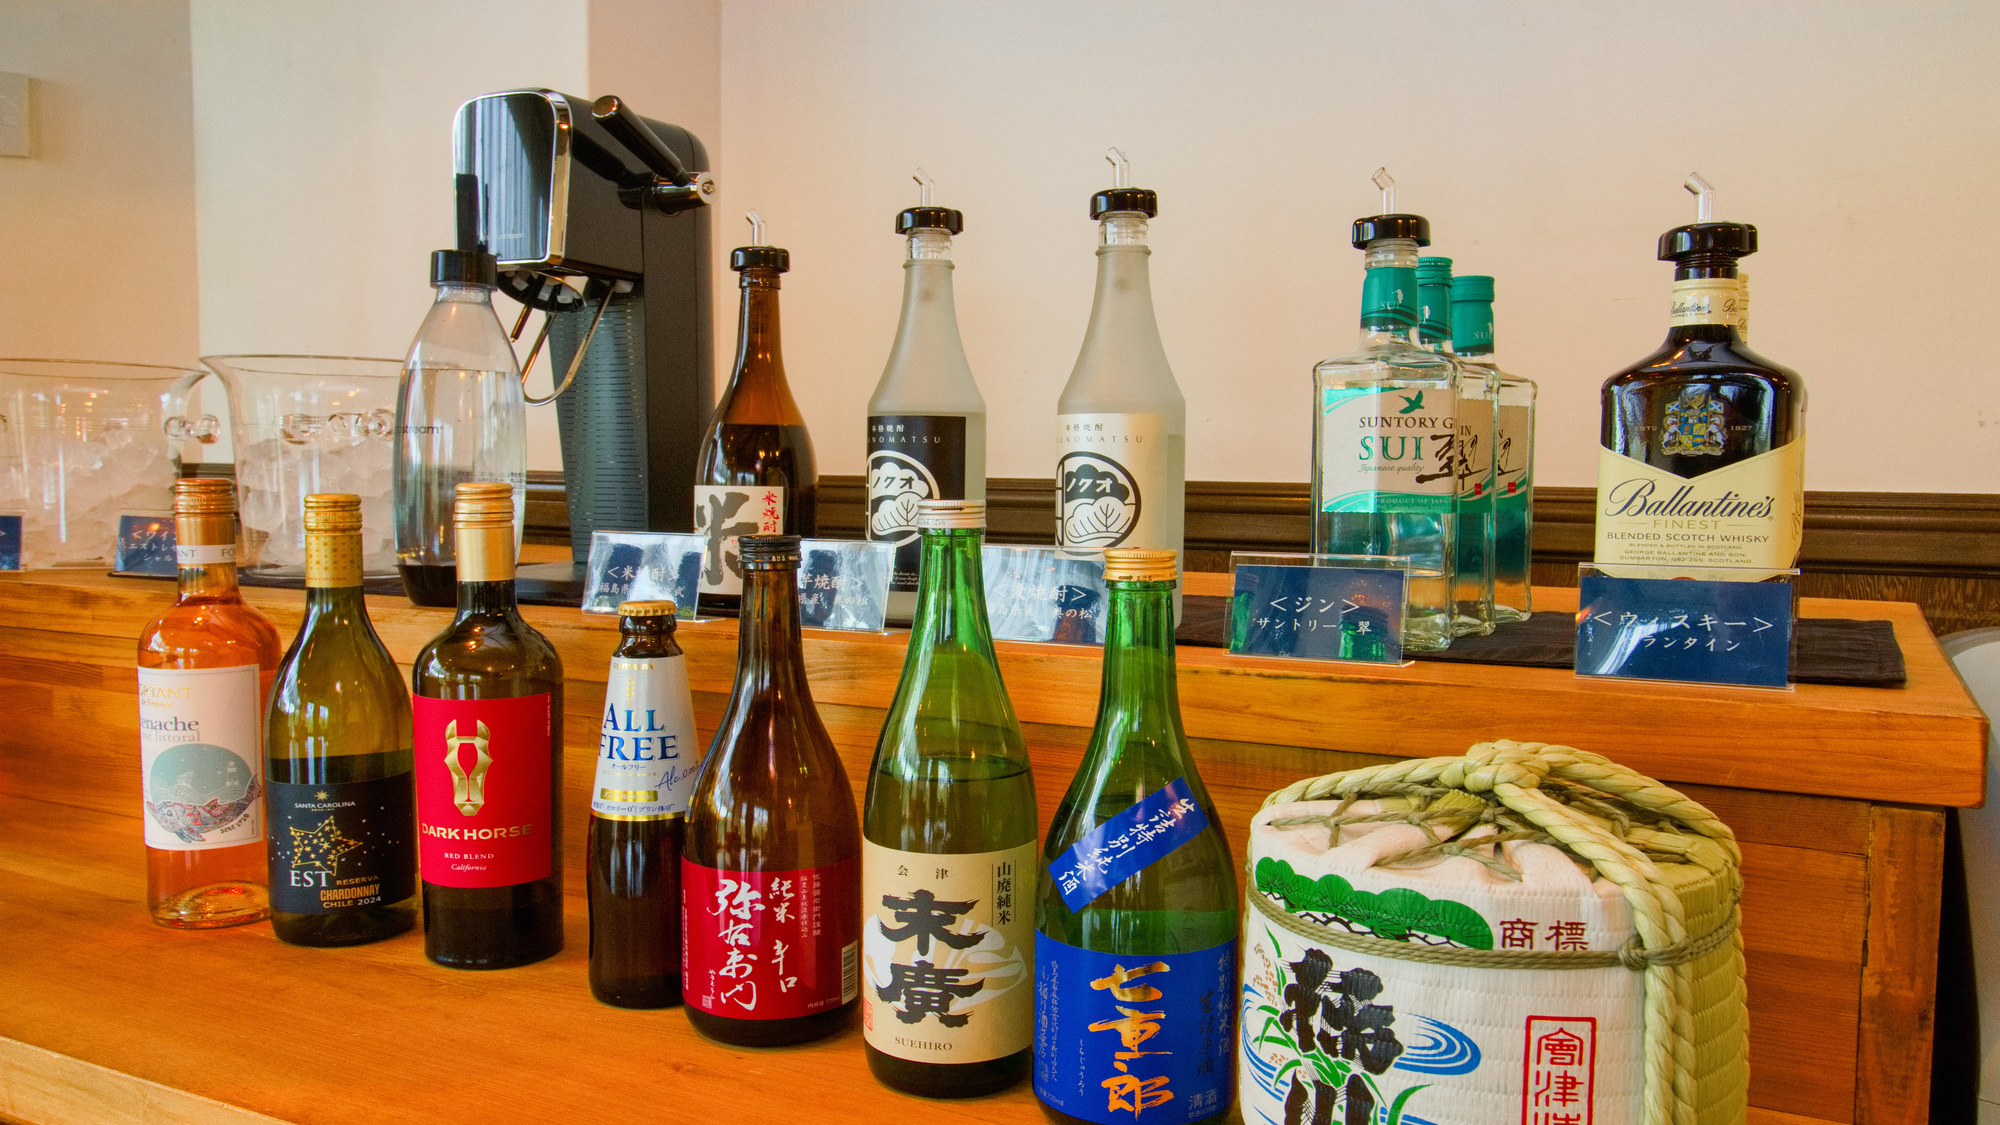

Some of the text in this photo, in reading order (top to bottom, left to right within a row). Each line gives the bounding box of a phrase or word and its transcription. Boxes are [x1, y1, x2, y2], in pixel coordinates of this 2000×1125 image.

[1359, 416, 1438, 429] SUNTORY
[1359, 435, 1425, 462] SUI
[1358, 463, 1424, 475] Japanese quality
[1605, 478, 1775, 517] Ballantine's
[762, 490, 780, 533] 米焼酎
[1653, 519, 1721, 530] FINEST
[1607, 531, 1770, 543] BLENDED SCOTCH WHISKY
[608, 565, 680, 581] <米酎>
[1257, 618, 1372, 635] サントリー 翠
[613, 663, 656, 671] SUNTORY
[603, 702, 666, 734] ALL
[155, 731, 200, 742] littoral
[598, 734, 680, 762] FREE
[317, 801, 356, 809] CAROLINA
[422, 823, 533, 840] DARK HORSE
[444, 852, 460, 860] RED
[451, 863, 487, 872] California
[898, 865, 949, 880] 会津
[289, 870, 333, 888] EST
[336, 875, 379, 886] RESERVA
[320, 884, 380, 901] CHARDONNAY
[996, 862, 1011, 925] 山廃純米
[323, 896, 382, 909] CHILE 2024
[1499, 918, 1589, 952] 商標
[895, 1036, 953, 1051] SUEHIRO
[1533, 1027, 1585, 1125] 會津
[1188, 1088, 1218, 1110] 清酒
